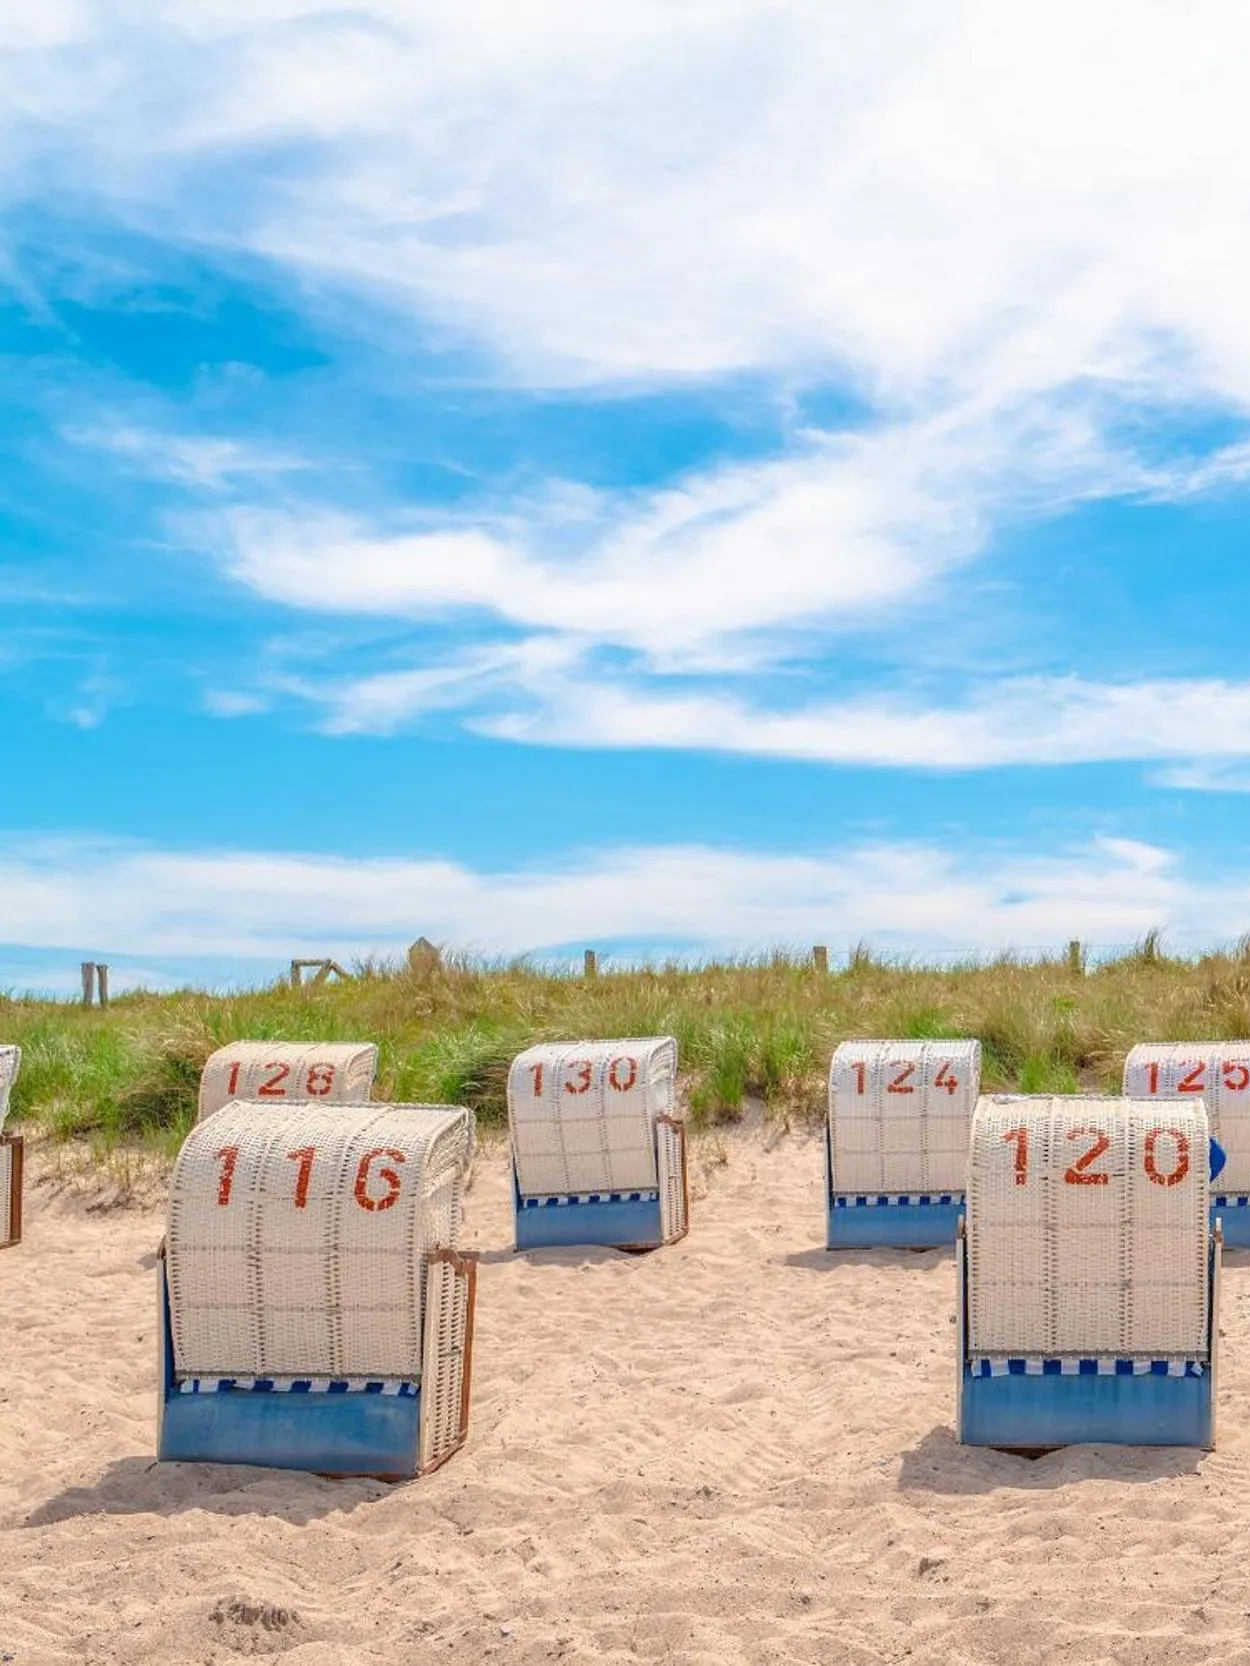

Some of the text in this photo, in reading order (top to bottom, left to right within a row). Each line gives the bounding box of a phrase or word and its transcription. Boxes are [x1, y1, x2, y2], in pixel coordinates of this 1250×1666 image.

[226, 1060, 337, 1098] 128
[532, 1055, 638, 1096] 130
[851, 1060, 959, 1096] 124
[1002, 1127, 1191, 1188] 120
[213, 1144, 408, 1214] 116
